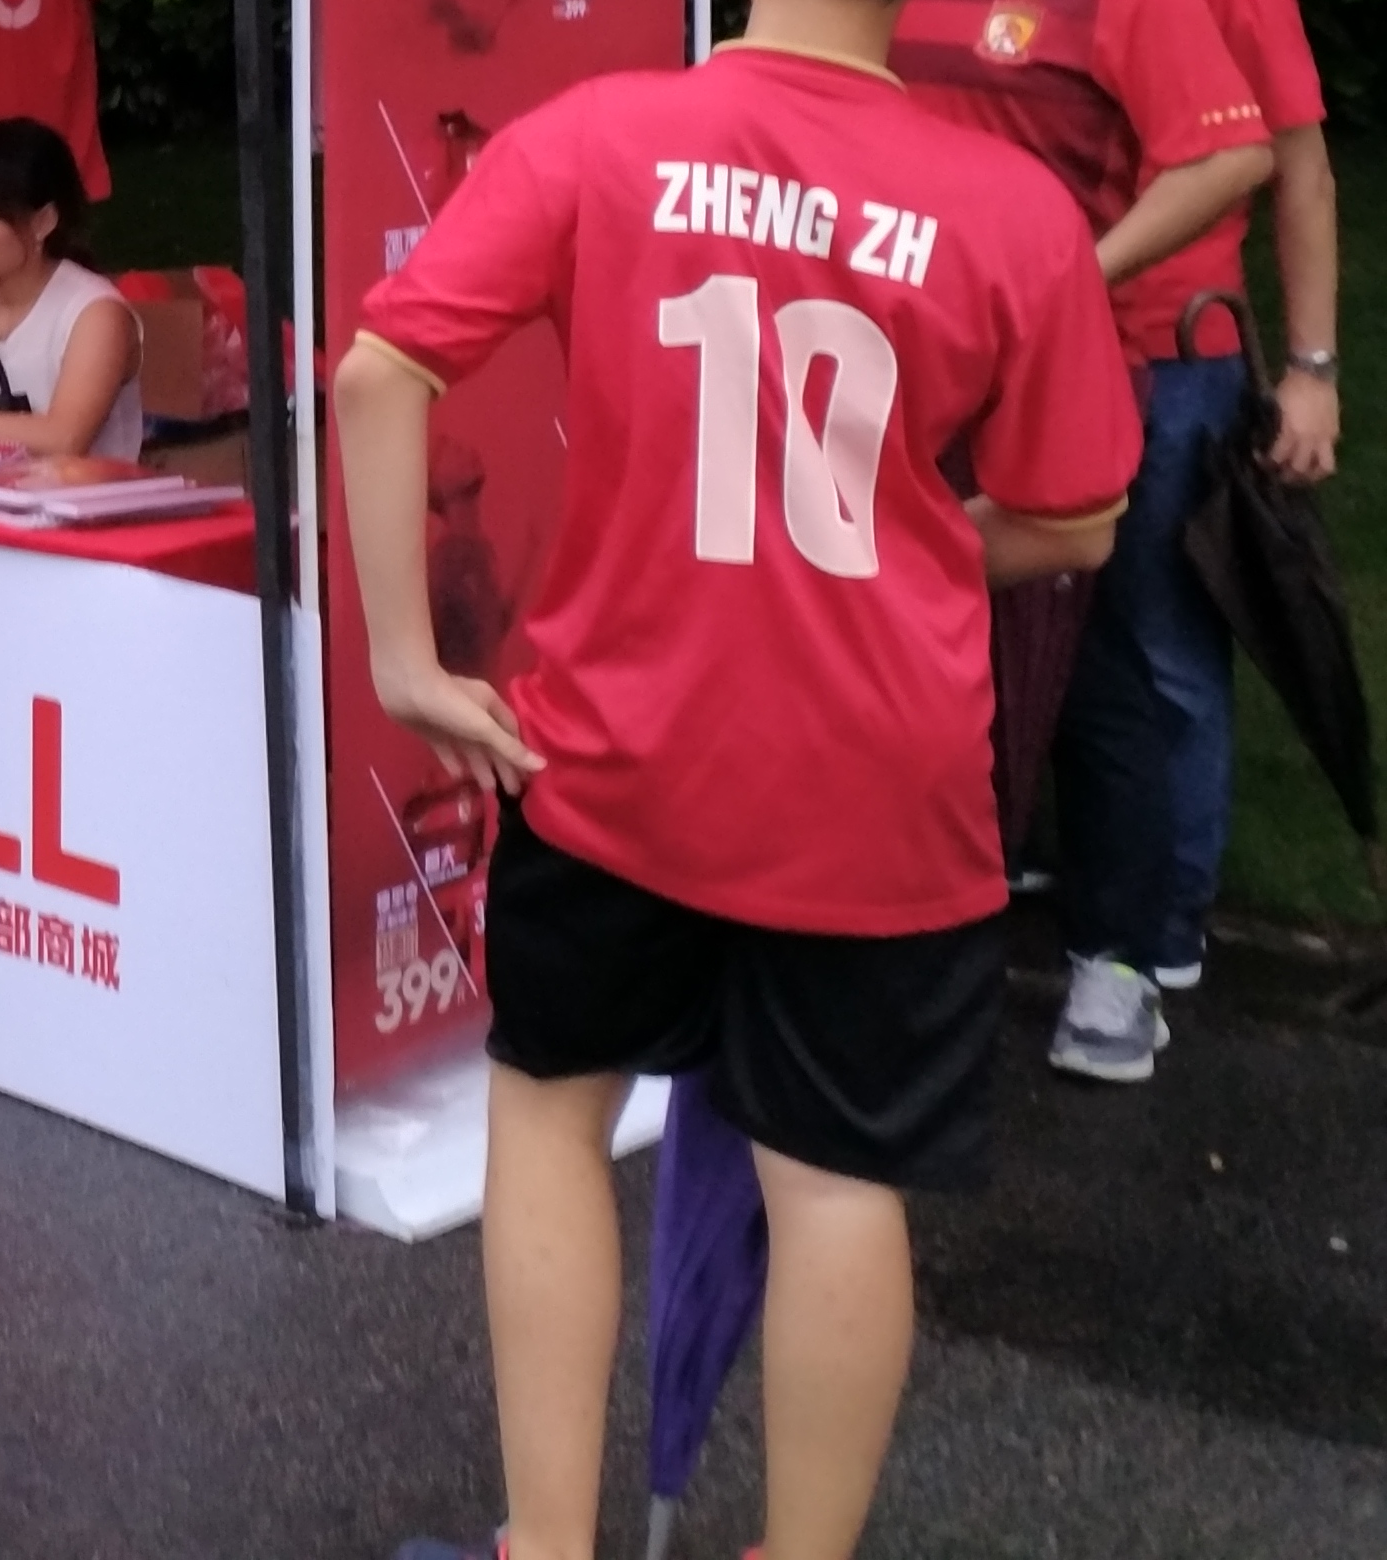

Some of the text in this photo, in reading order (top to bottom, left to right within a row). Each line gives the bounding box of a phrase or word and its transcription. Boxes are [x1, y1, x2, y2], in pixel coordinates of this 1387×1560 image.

[654, 160, 938, 289] ZHENG ZH
[659, 274, 898, 580] 10
[375, 948, 459, 1034] 399
